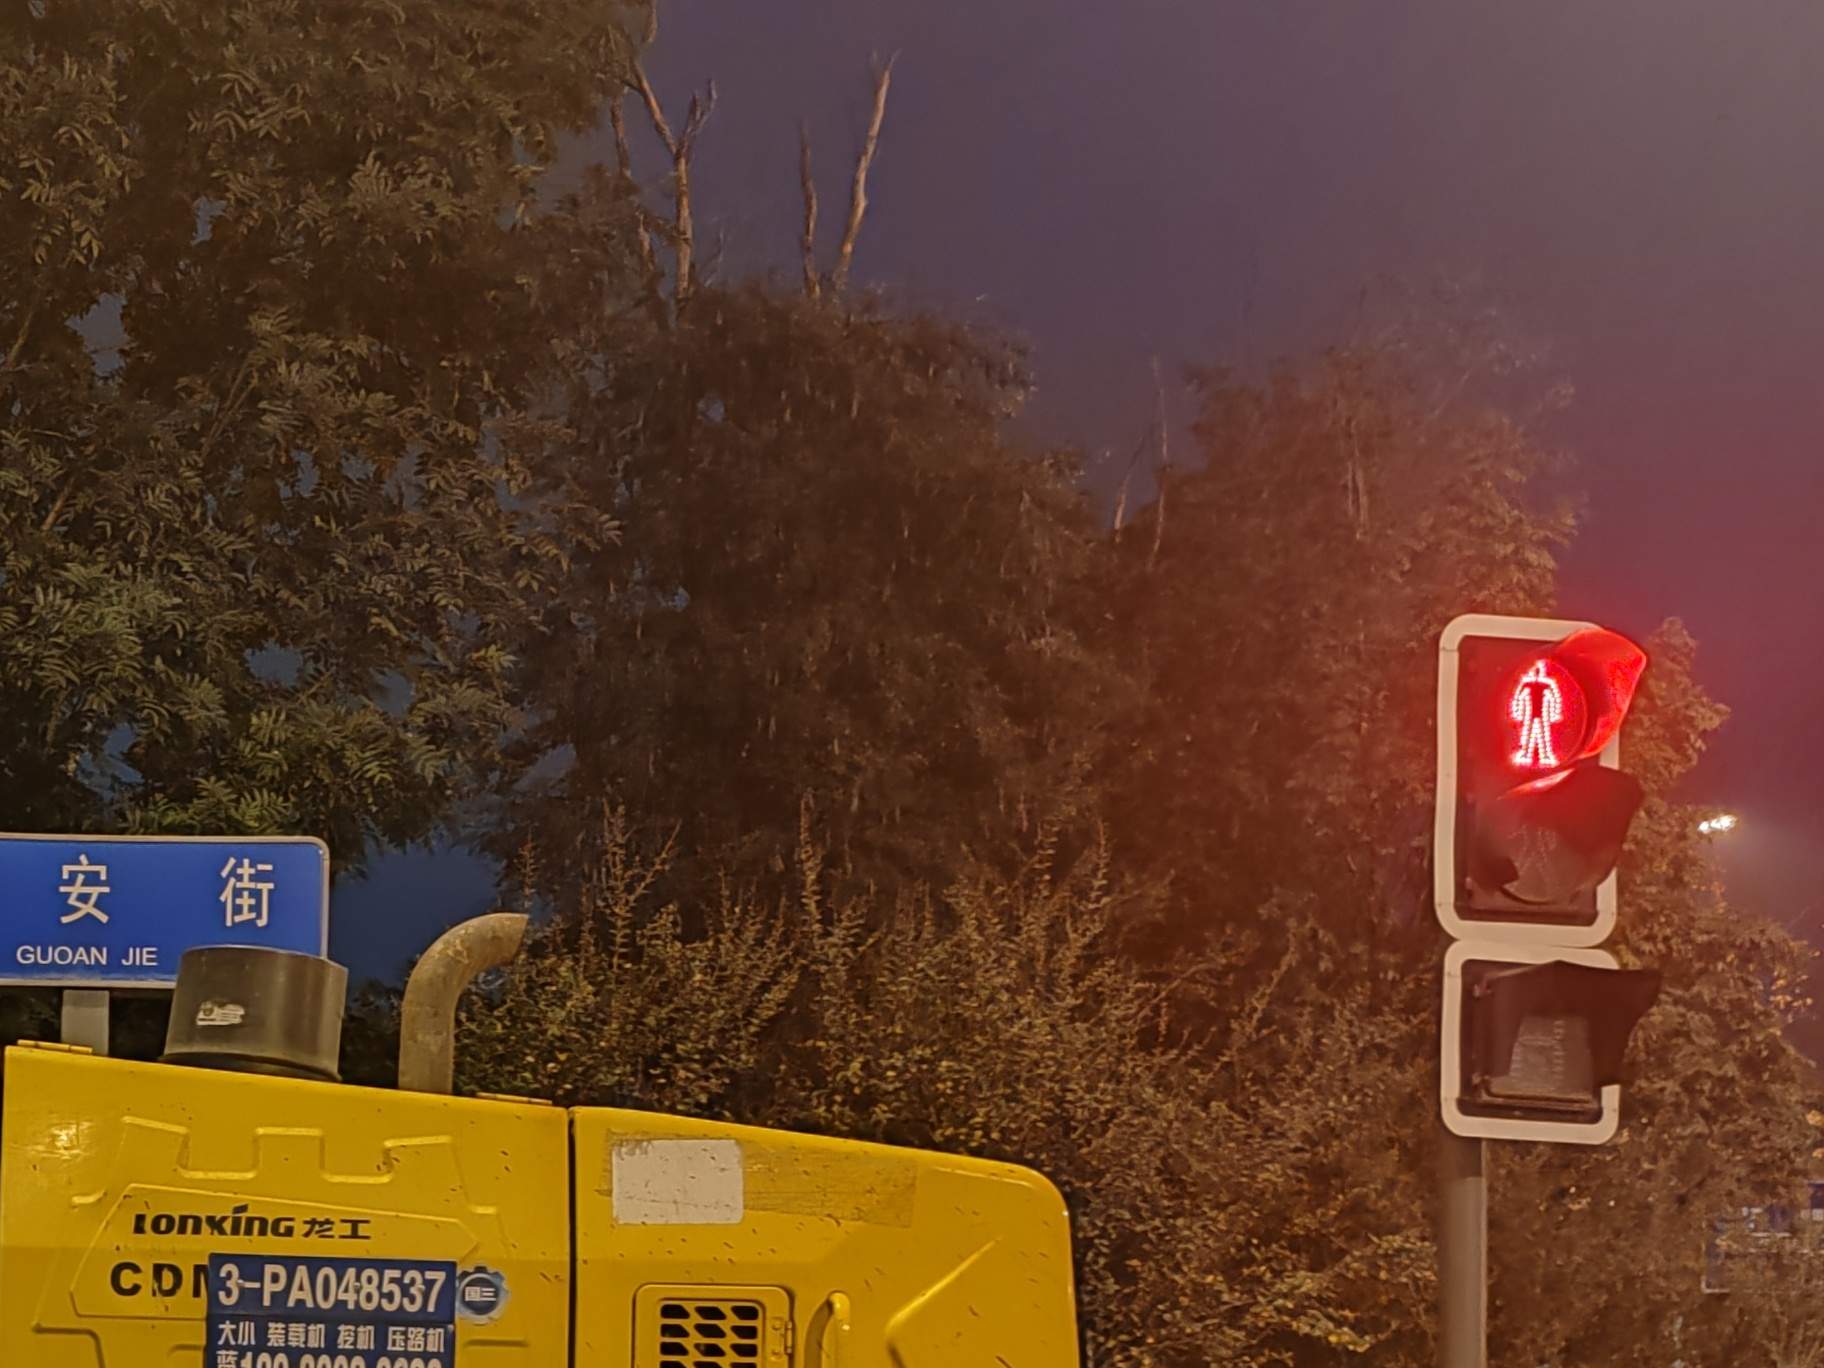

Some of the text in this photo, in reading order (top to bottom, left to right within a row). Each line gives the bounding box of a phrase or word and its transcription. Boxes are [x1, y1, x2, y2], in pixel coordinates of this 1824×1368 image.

[17, 944, 107, 966] GUOAN
[121, 946, 158, 966] JIE
[302, 1218, 372, 1240] 龙工
[218, 1263, 446, 1314] 3-PA048537
[218, 1320, 444, 1353] 大小 装载机 挖机 压路机
